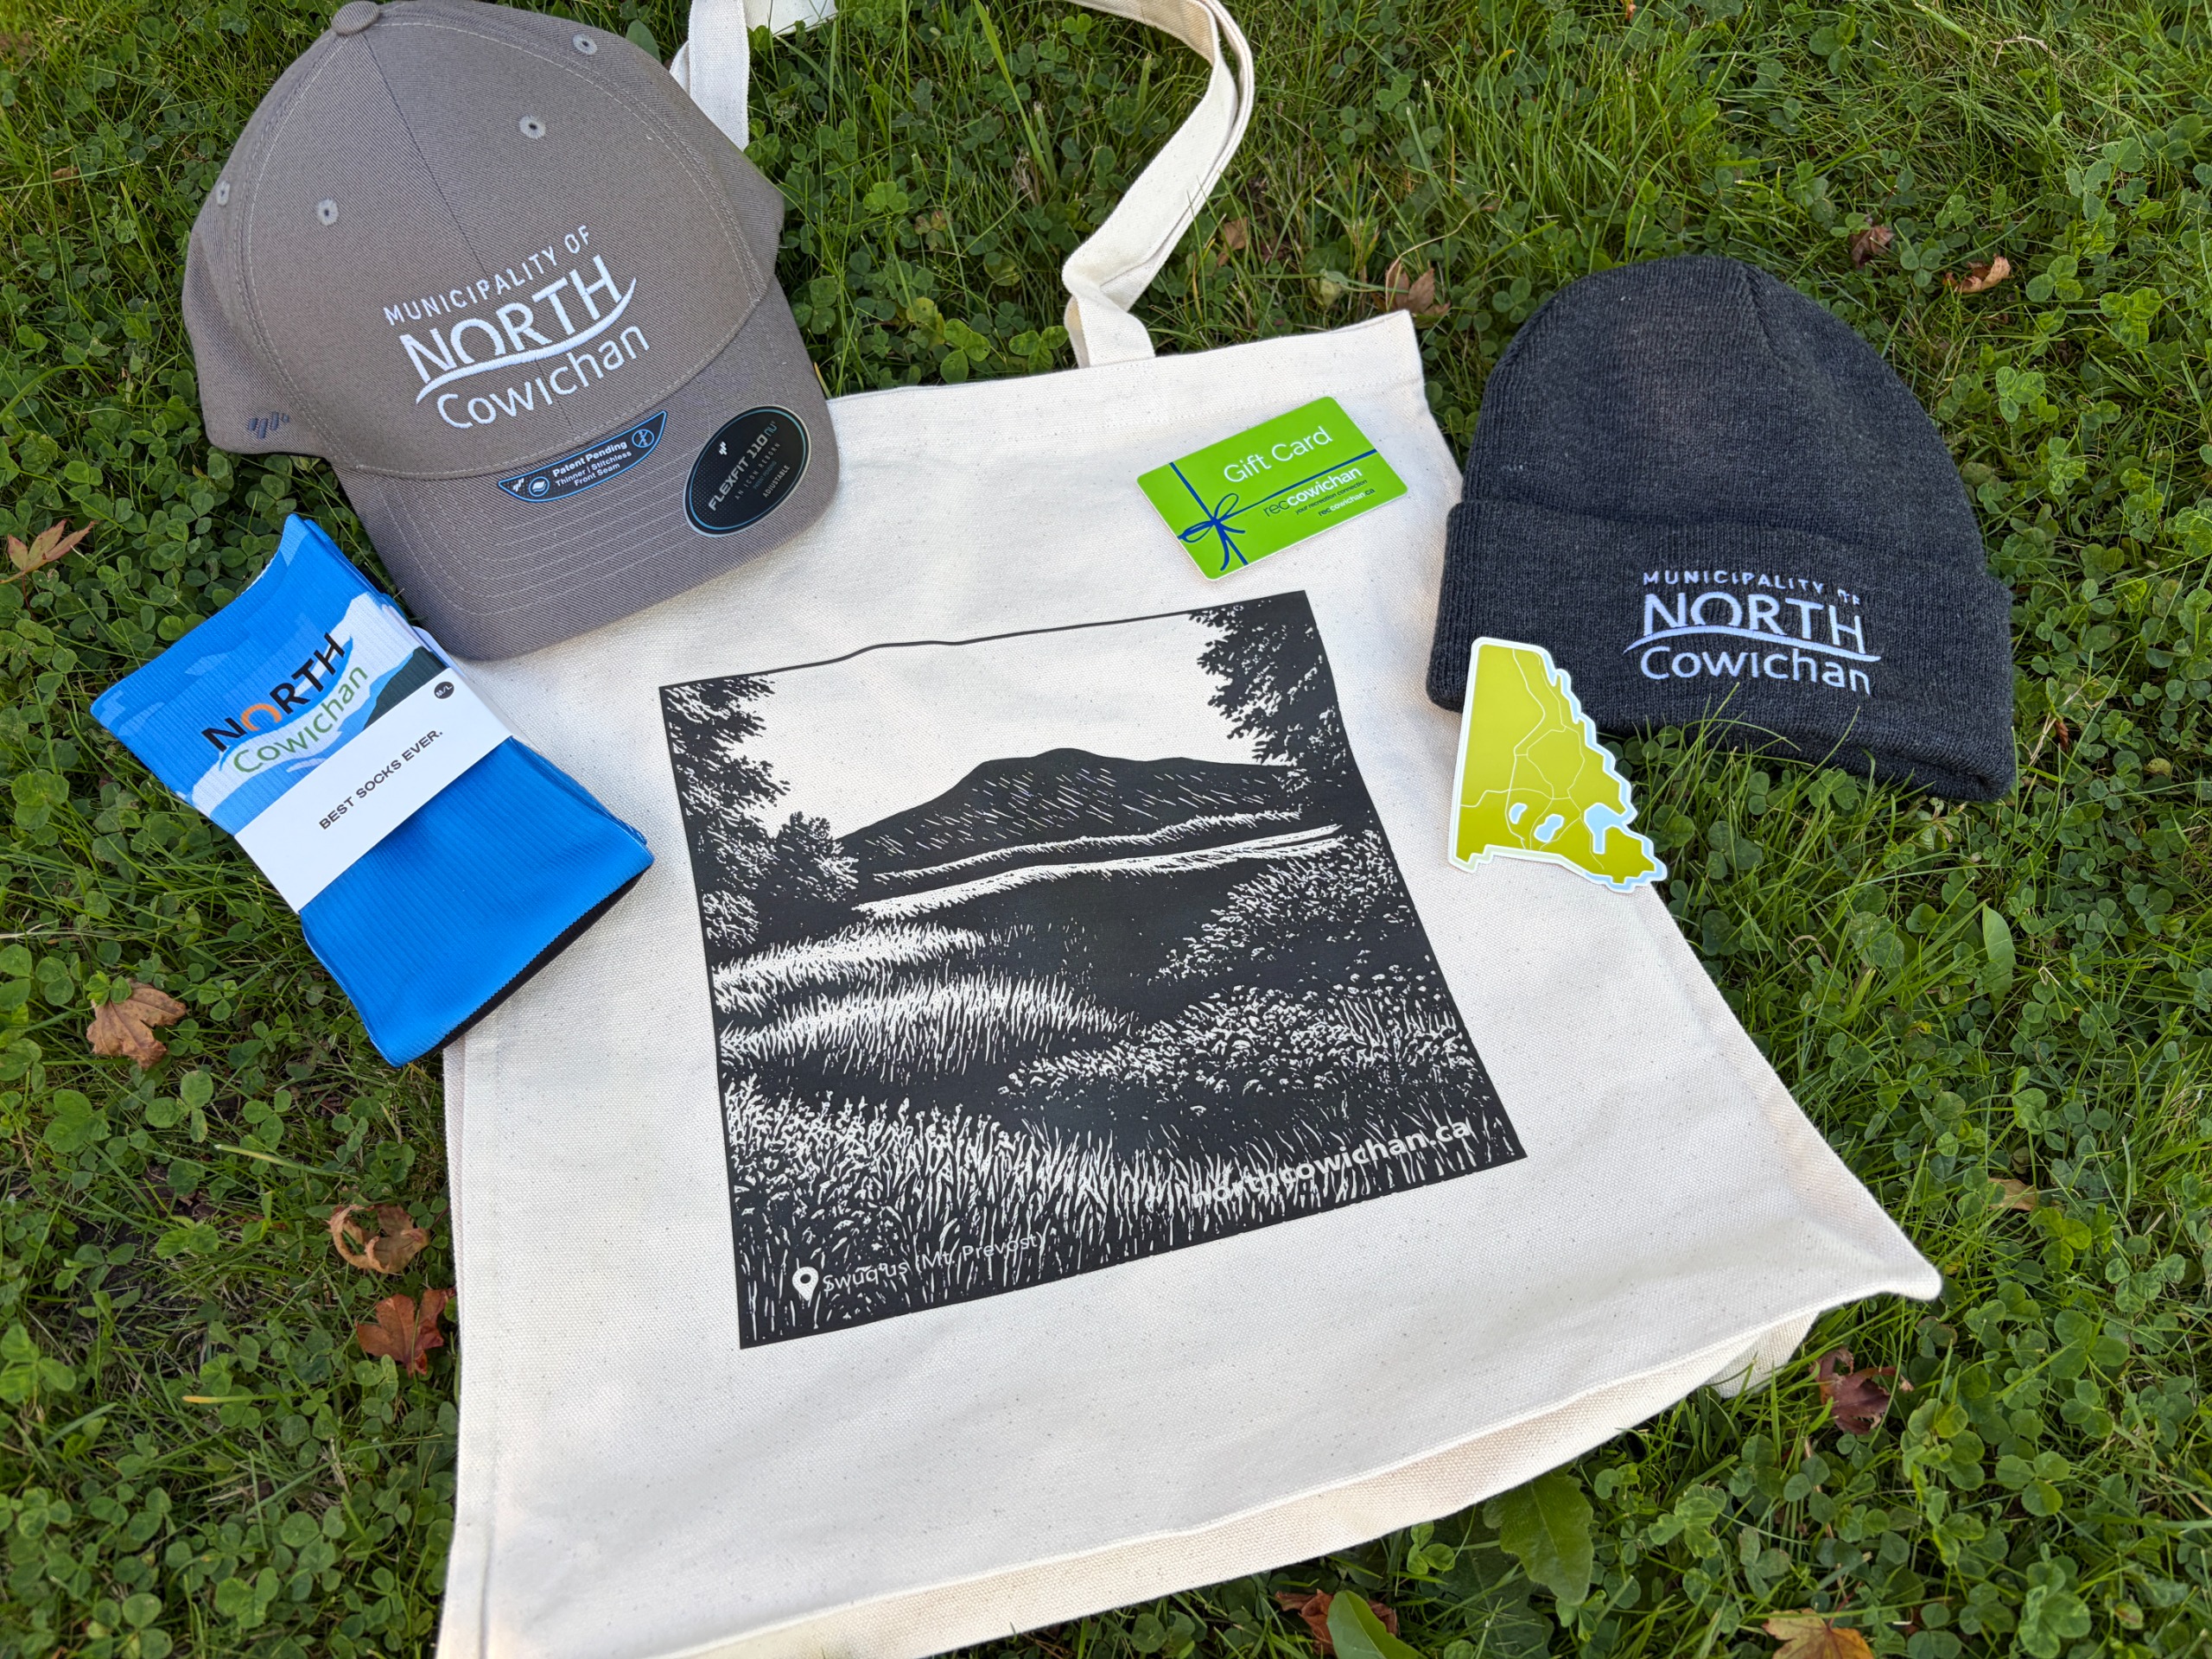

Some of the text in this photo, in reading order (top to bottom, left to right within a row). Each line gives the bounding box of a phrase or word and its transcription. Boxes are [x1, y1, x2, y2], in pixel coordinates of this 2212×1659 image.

[383, 225, 589, 326] MUNICIPALITY OF
[399, 255, 622, 383] NORTH
[437, 326, 650, 429] Cowichan
[553, 442, 628, 477] Patent Pending
[555, 469, 586, 486] Thinner
[591, 451, 632, 471] Stitchless
[574, 463, 620, 486] Front Seam
[709, 456, 748, 511] FLEXFIT
[747, 434, 768, 459] 110
[734, 442, 781, 500] AN ICON REBORN
[763, 465, 791, 499] ADJUSTABLE
[1224, 426, 1333, 483] Gift Card
[1262, 467, 1363, 517] reccowichan
[1295, 480, 1367, 515] your recreation connection
[1318, 487, 1376, 517] reccowichan.ca
[1643, 569, 1824, 594] MUNICIPALITY
[1643, 591, 1866, 654] NORTH
[201, 632, 346, 753] NORTH
[435, 685, 454, 697] M/L
[1641, 645, 1871, 696] Cowichan
[233, 666, 369, 772] Cowichan
[318, 730, 443, 830] BEST SOCKS EVER.
[1192, 1122, 1471, 1209] northcowichan.ca
